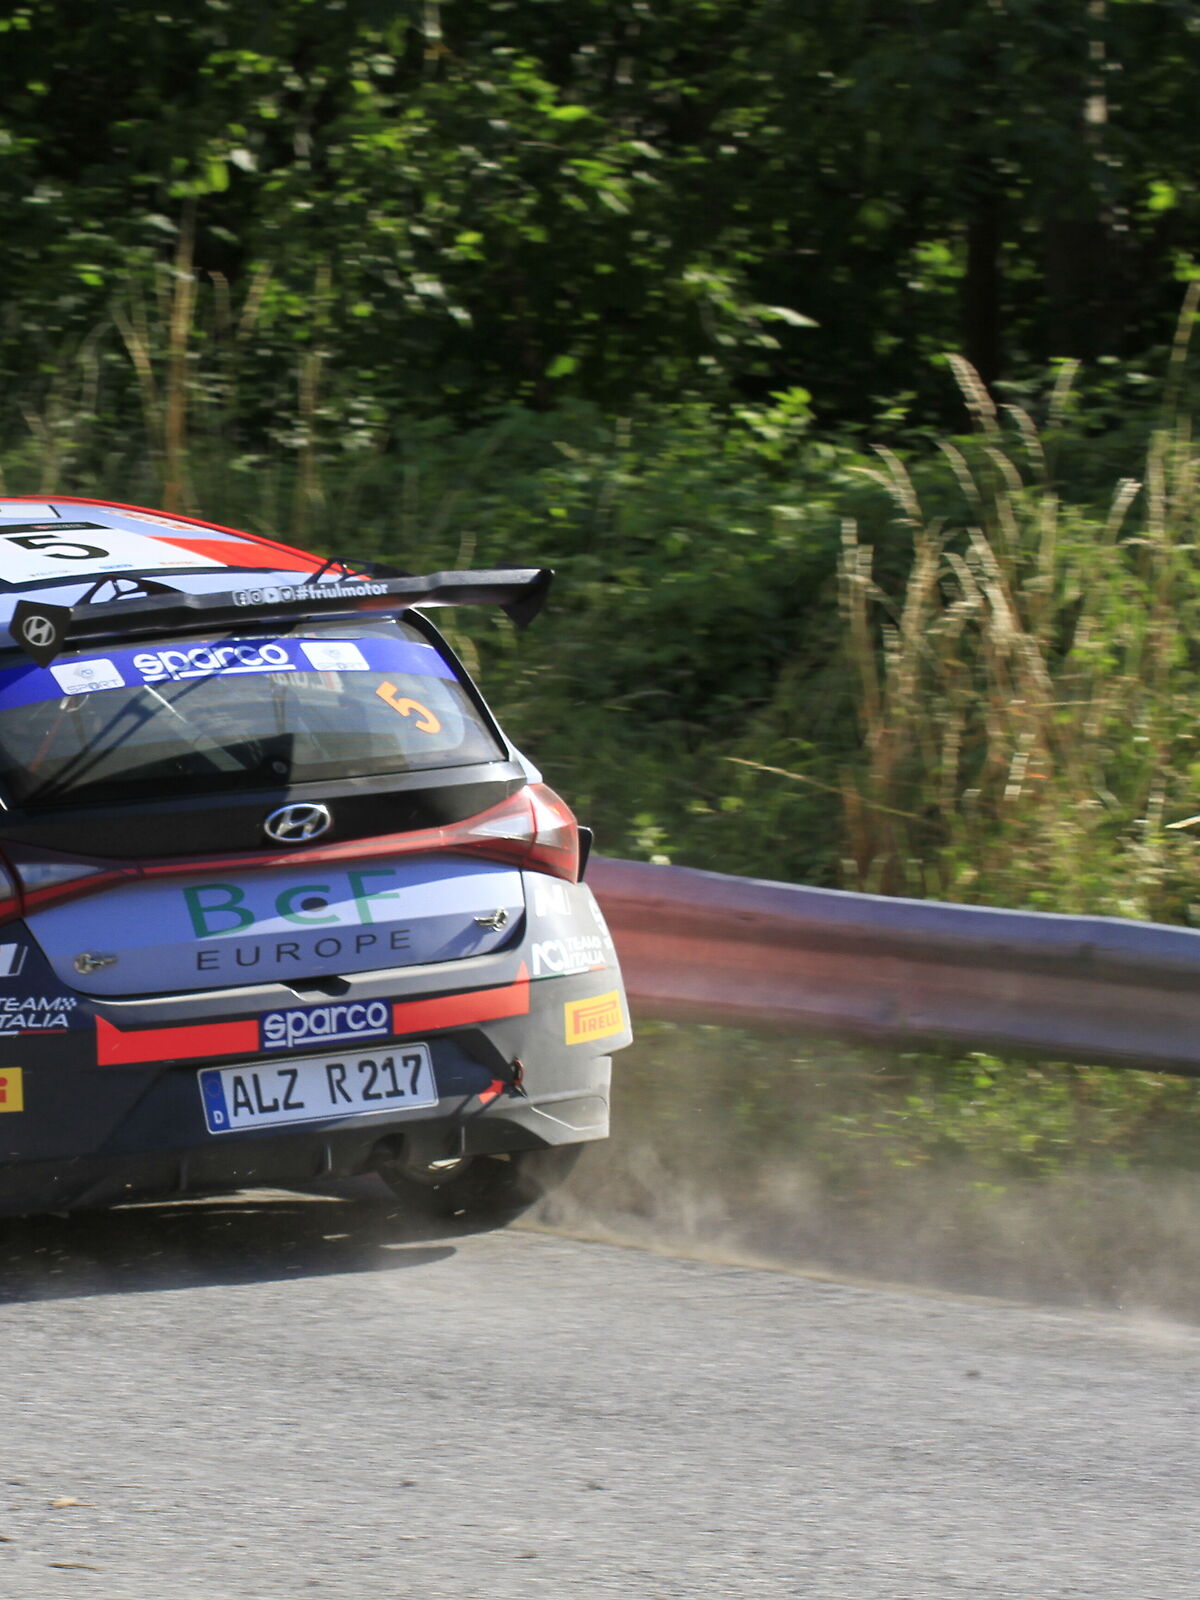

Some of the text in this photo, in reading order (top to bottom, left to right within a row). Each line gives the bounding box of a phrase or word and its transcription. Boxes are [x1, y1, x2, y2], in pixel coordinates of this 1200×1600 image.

[4, 535, 109, 559] 5
[294, 582, 389, 601] #friulmotor
[133, 643, 290, 681] sparco
[66, 679, 121, 694] SPORT
[376, 681, 441, 734] 5
[196, 929, 412, 971] EUROPE
[568, 951, 607, 968] ITALIA
[264, 1001, 389, 1048] sparco
[573, 1000, 621, 1035] PIRELLI
[233, 1068, 304, 1117] ALZ
[213, 1110, 224, 1125] D
